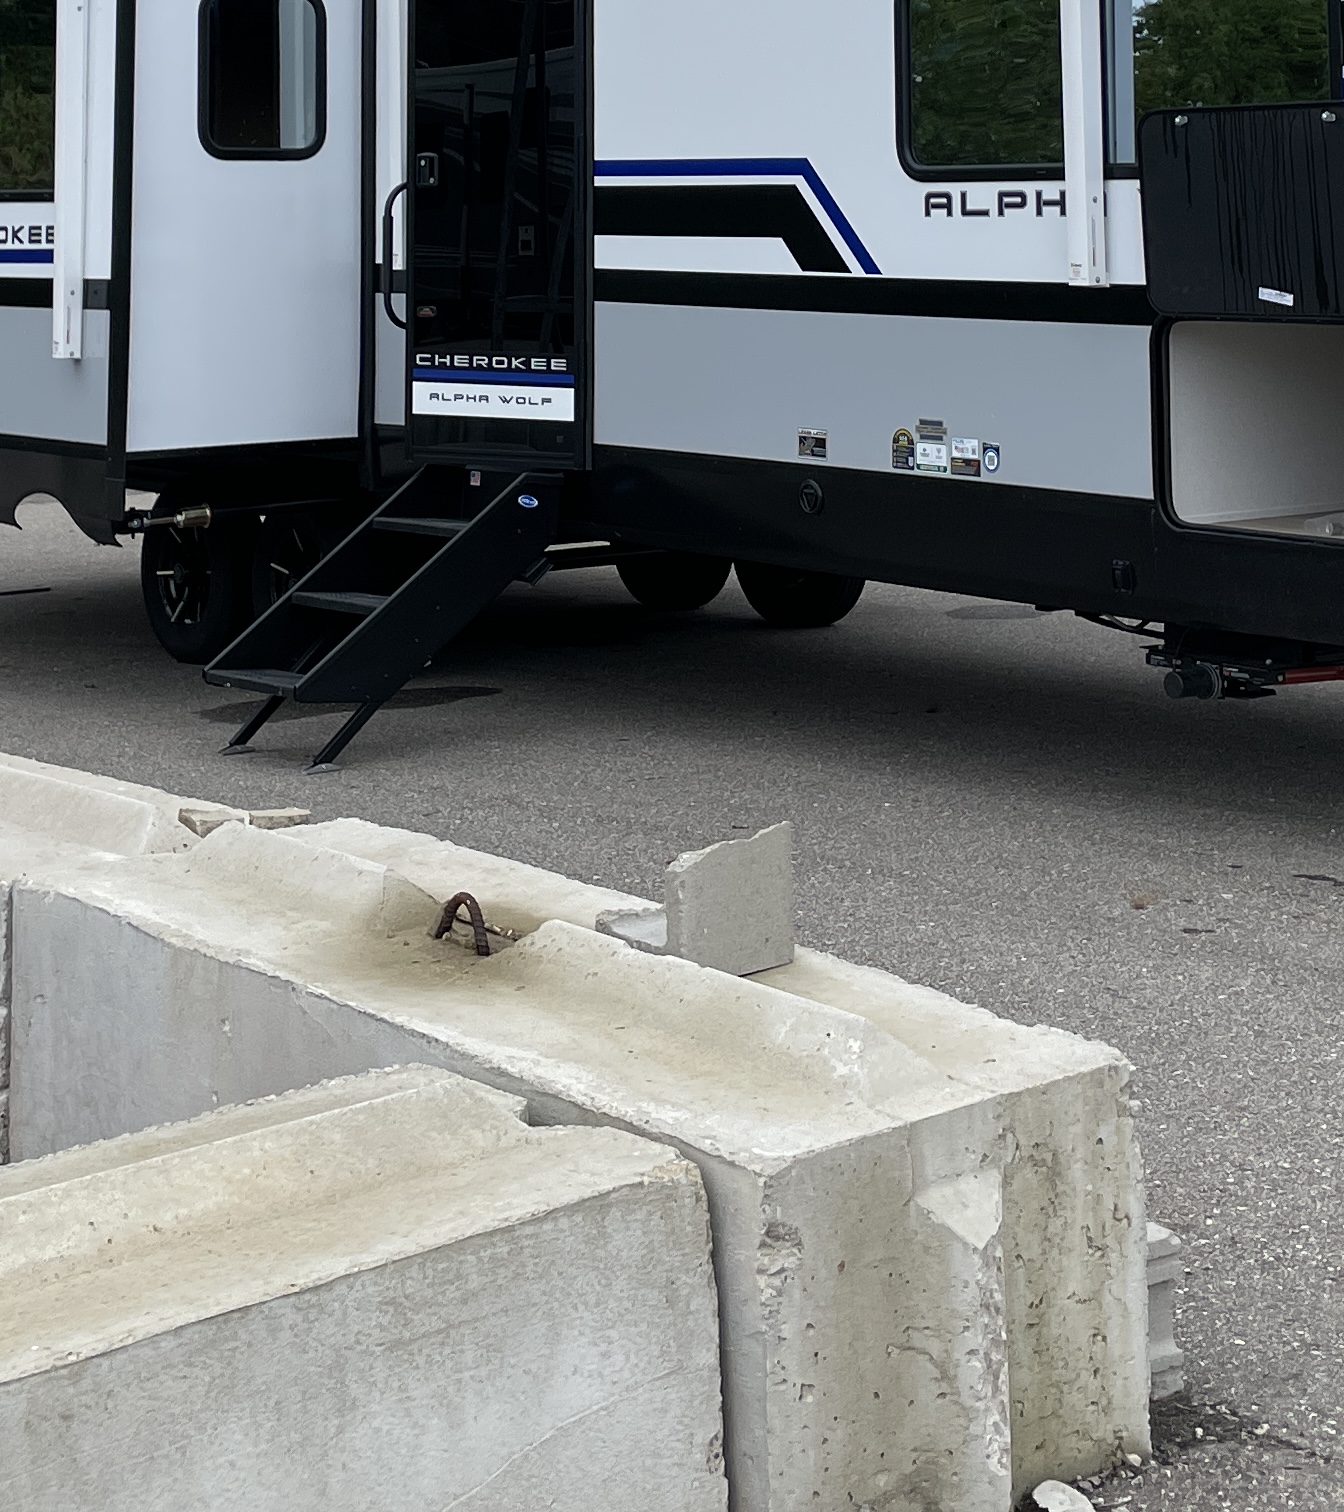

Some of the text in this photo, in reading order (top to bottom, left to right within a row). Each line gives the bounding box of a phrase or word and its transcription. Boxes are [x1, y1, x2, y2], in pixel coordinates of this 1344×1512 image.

[923, 189, 1108, 218] ALPH
[415, 353, 567, 371] CHEROKEE
[428, 392, 552, 406] ALPHA WOLF
